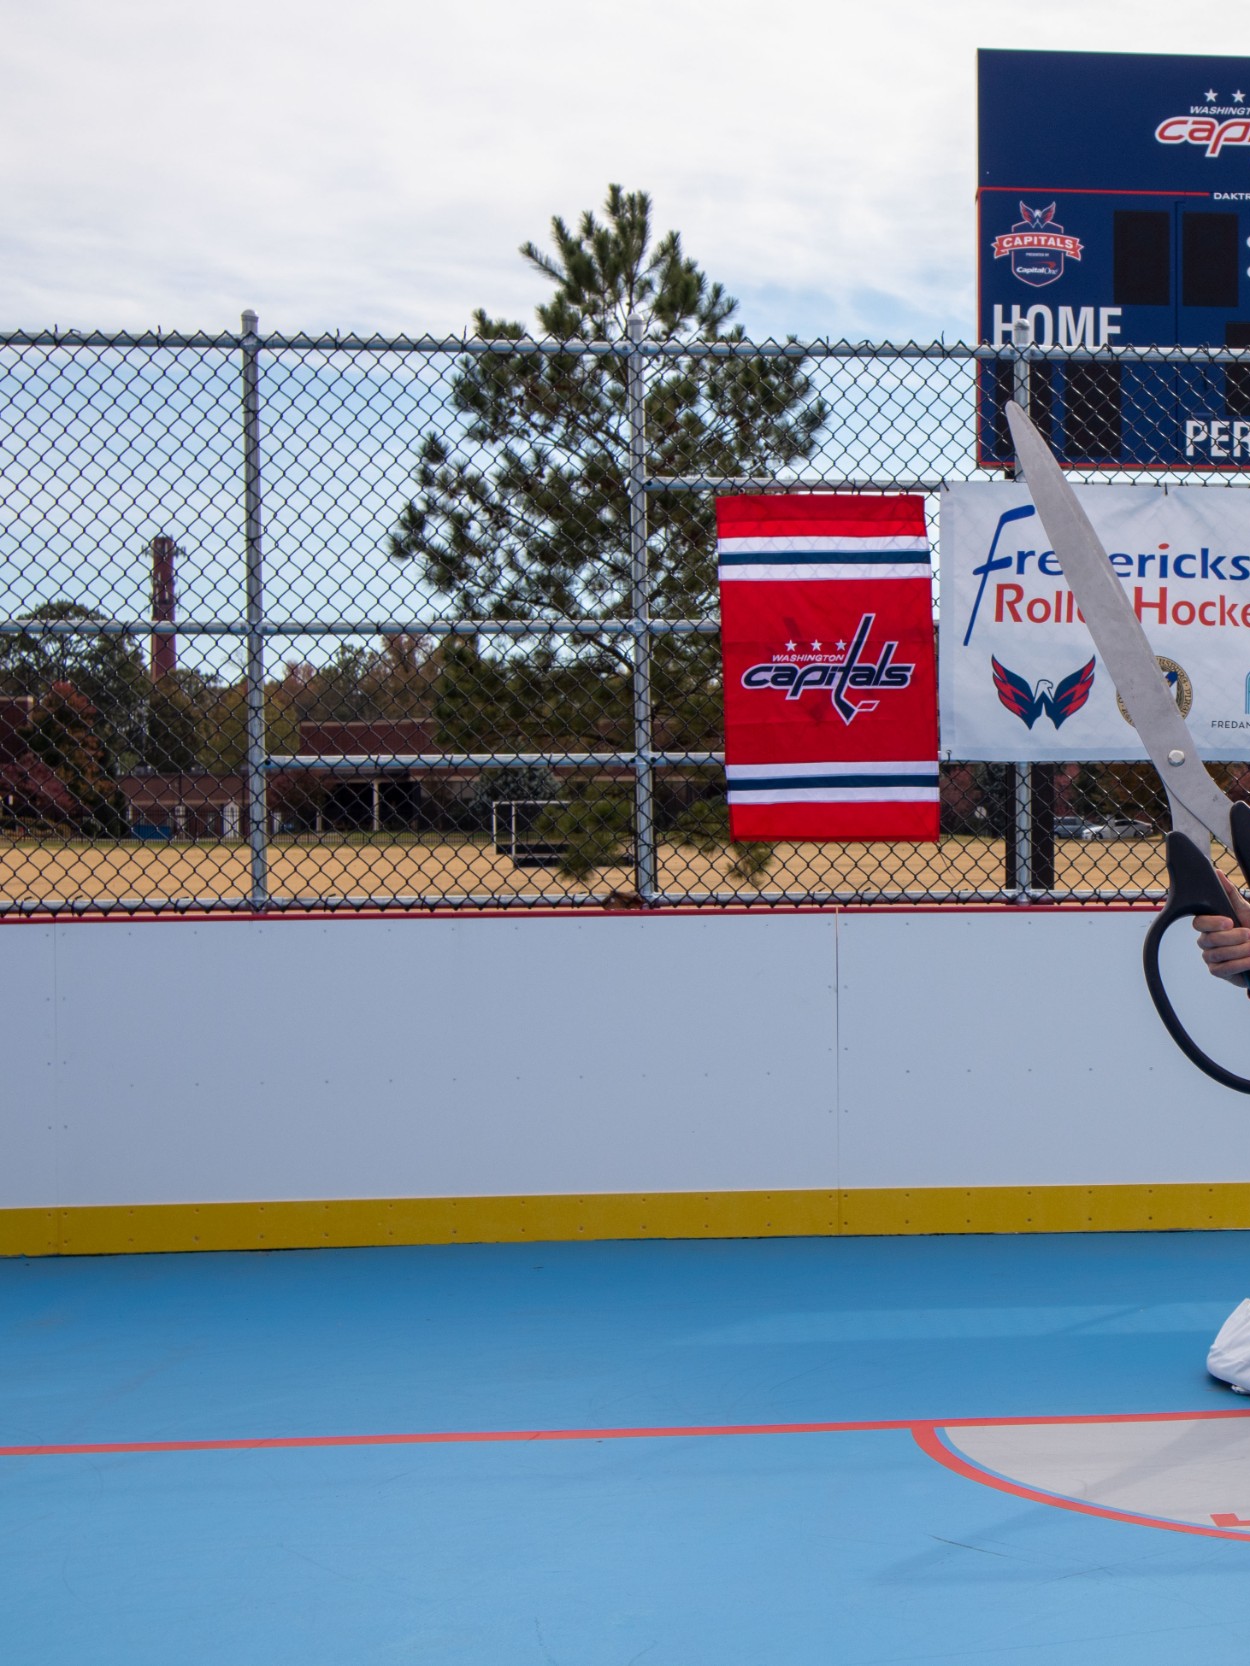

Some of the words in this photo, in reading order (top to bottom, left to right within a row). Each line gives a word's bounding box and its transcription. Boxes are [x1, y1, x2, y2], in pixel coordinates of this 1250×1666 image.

[1003, 236, 1073, 249] CAPITALS
[993, 304, 1122, 347] HOME
[994, 583, 1086, 624] Roll
[771, 654, 846, 663] WASHINGTON
